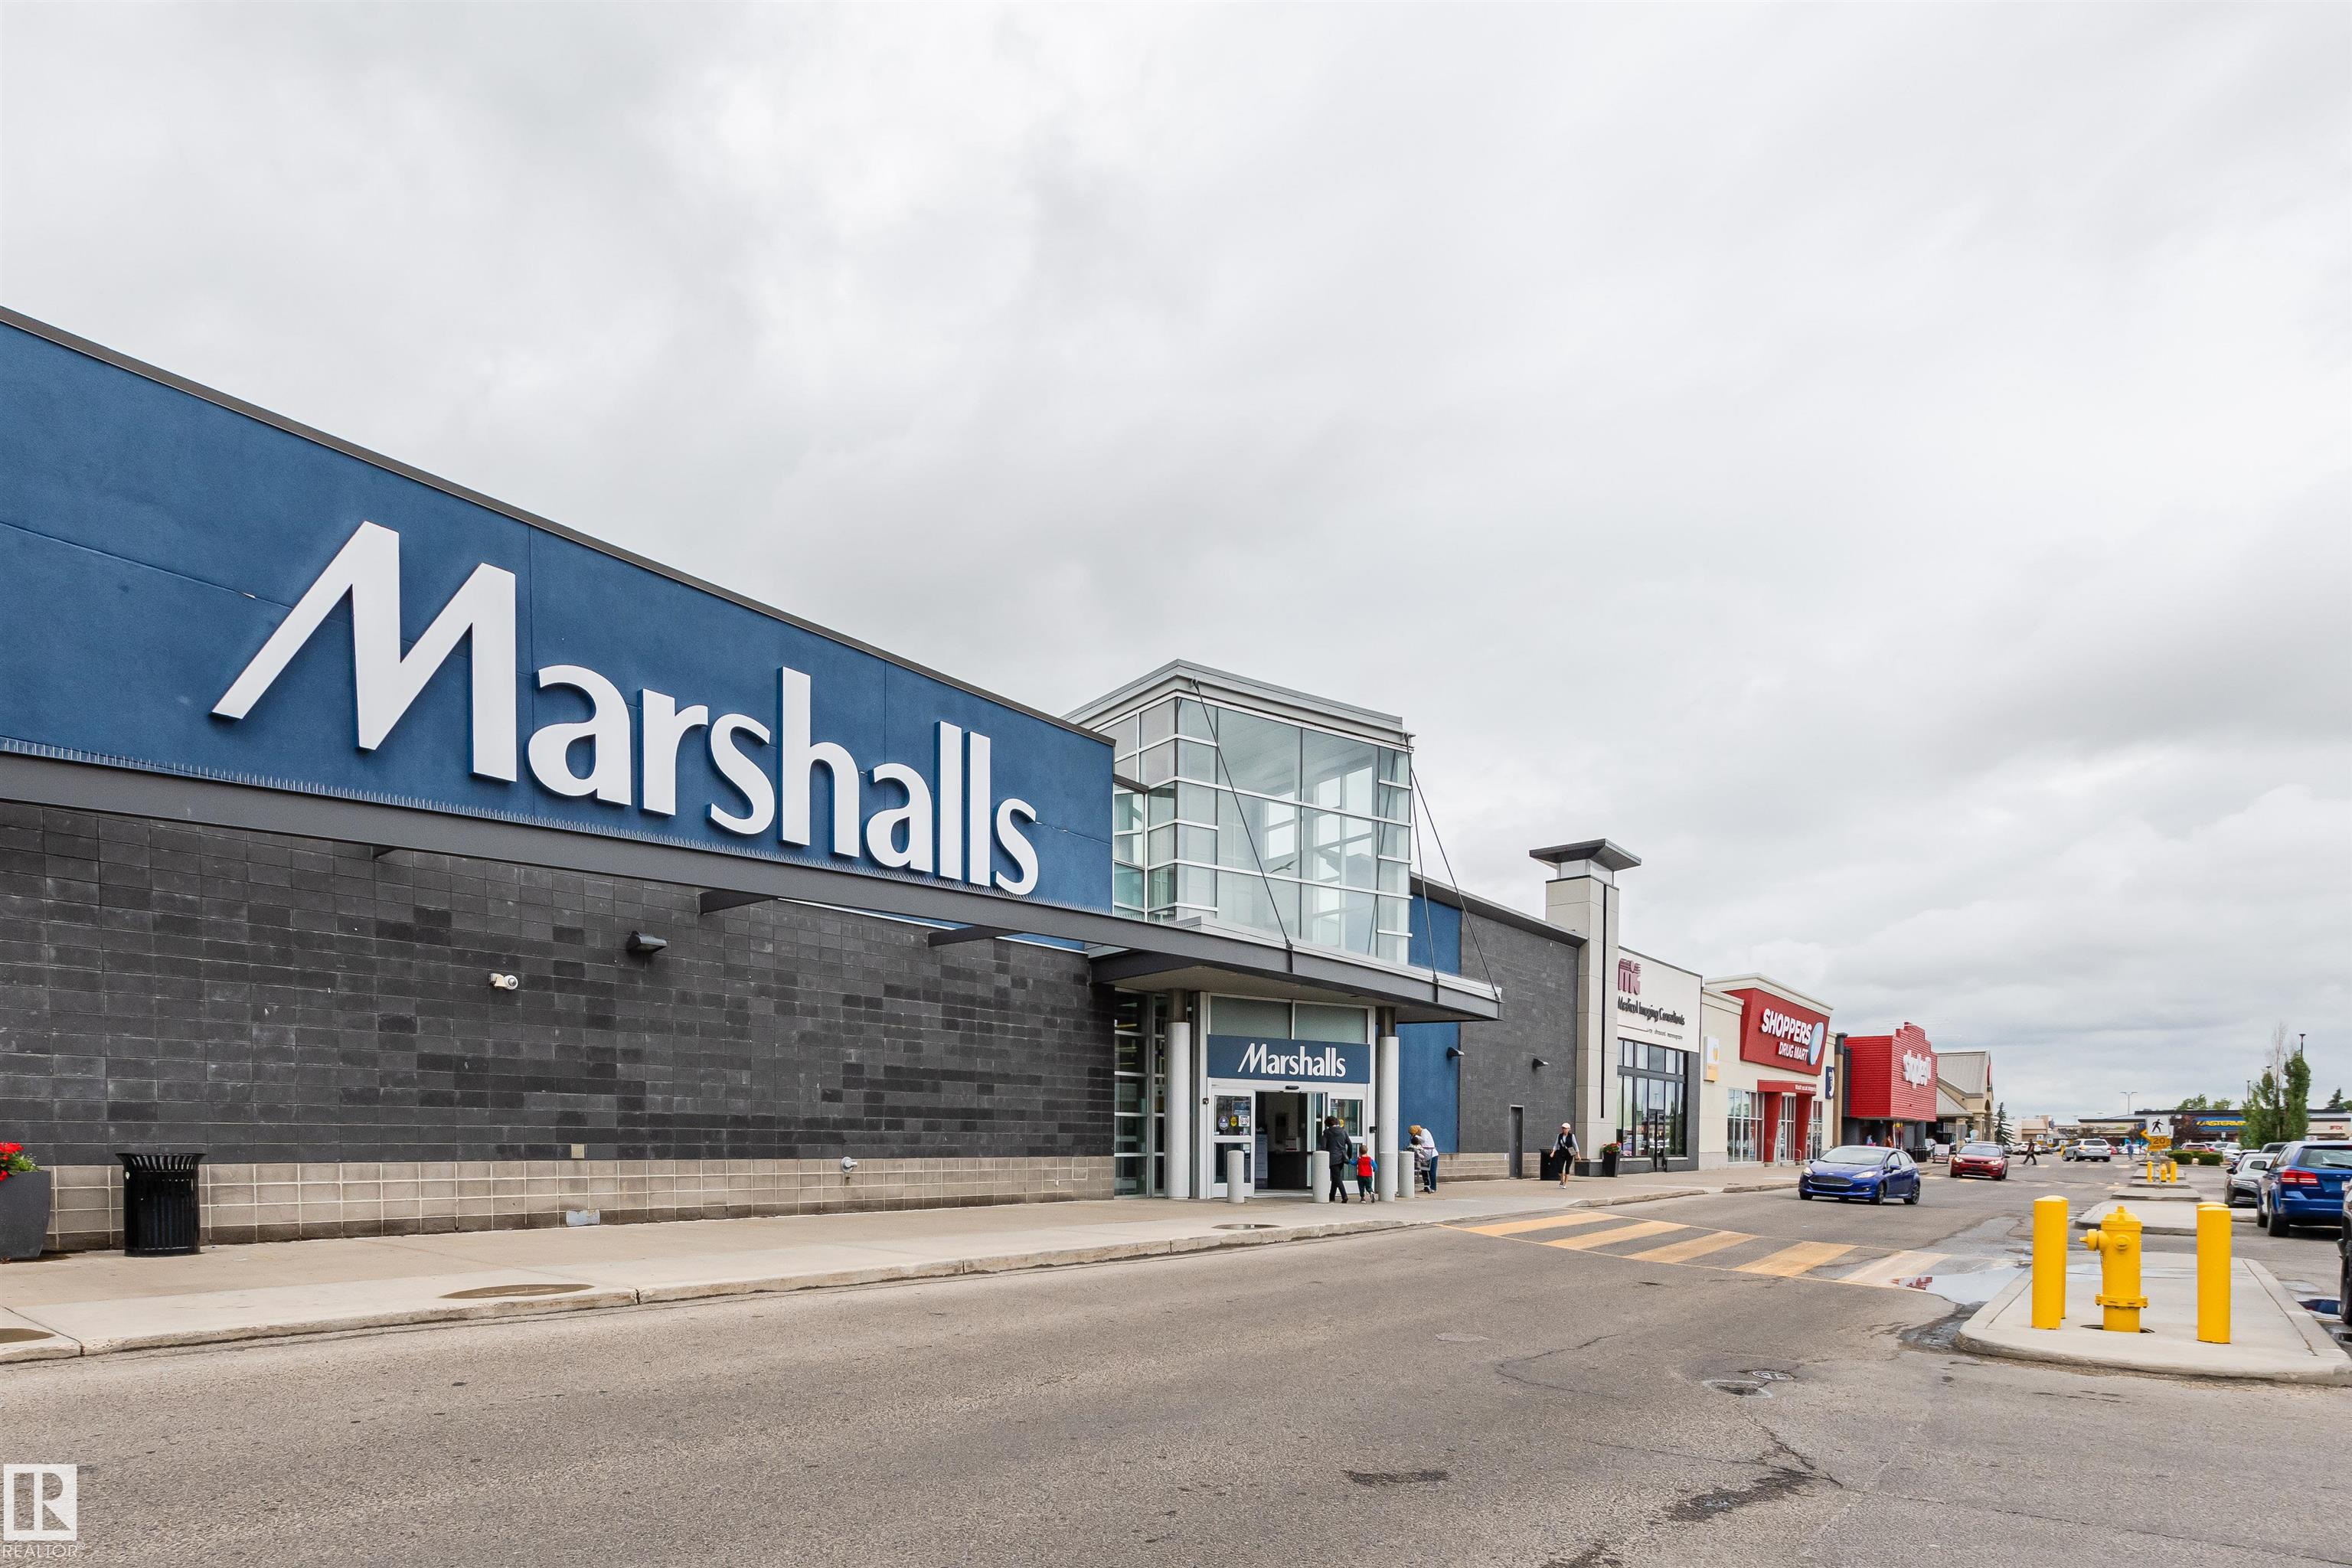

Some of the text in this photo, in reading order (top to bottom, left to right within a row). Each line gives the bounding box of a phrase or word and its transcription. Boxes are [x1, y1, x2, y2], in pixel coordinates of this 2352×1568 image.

[212, 521, 1038, 897] Marshalls
[1761, 1008, 1812, 1046] SHOPPERS
[1237, 1043, 1346, 1077] Marshalls
[1778, 1041, 1809, 1062] DRUG MART
